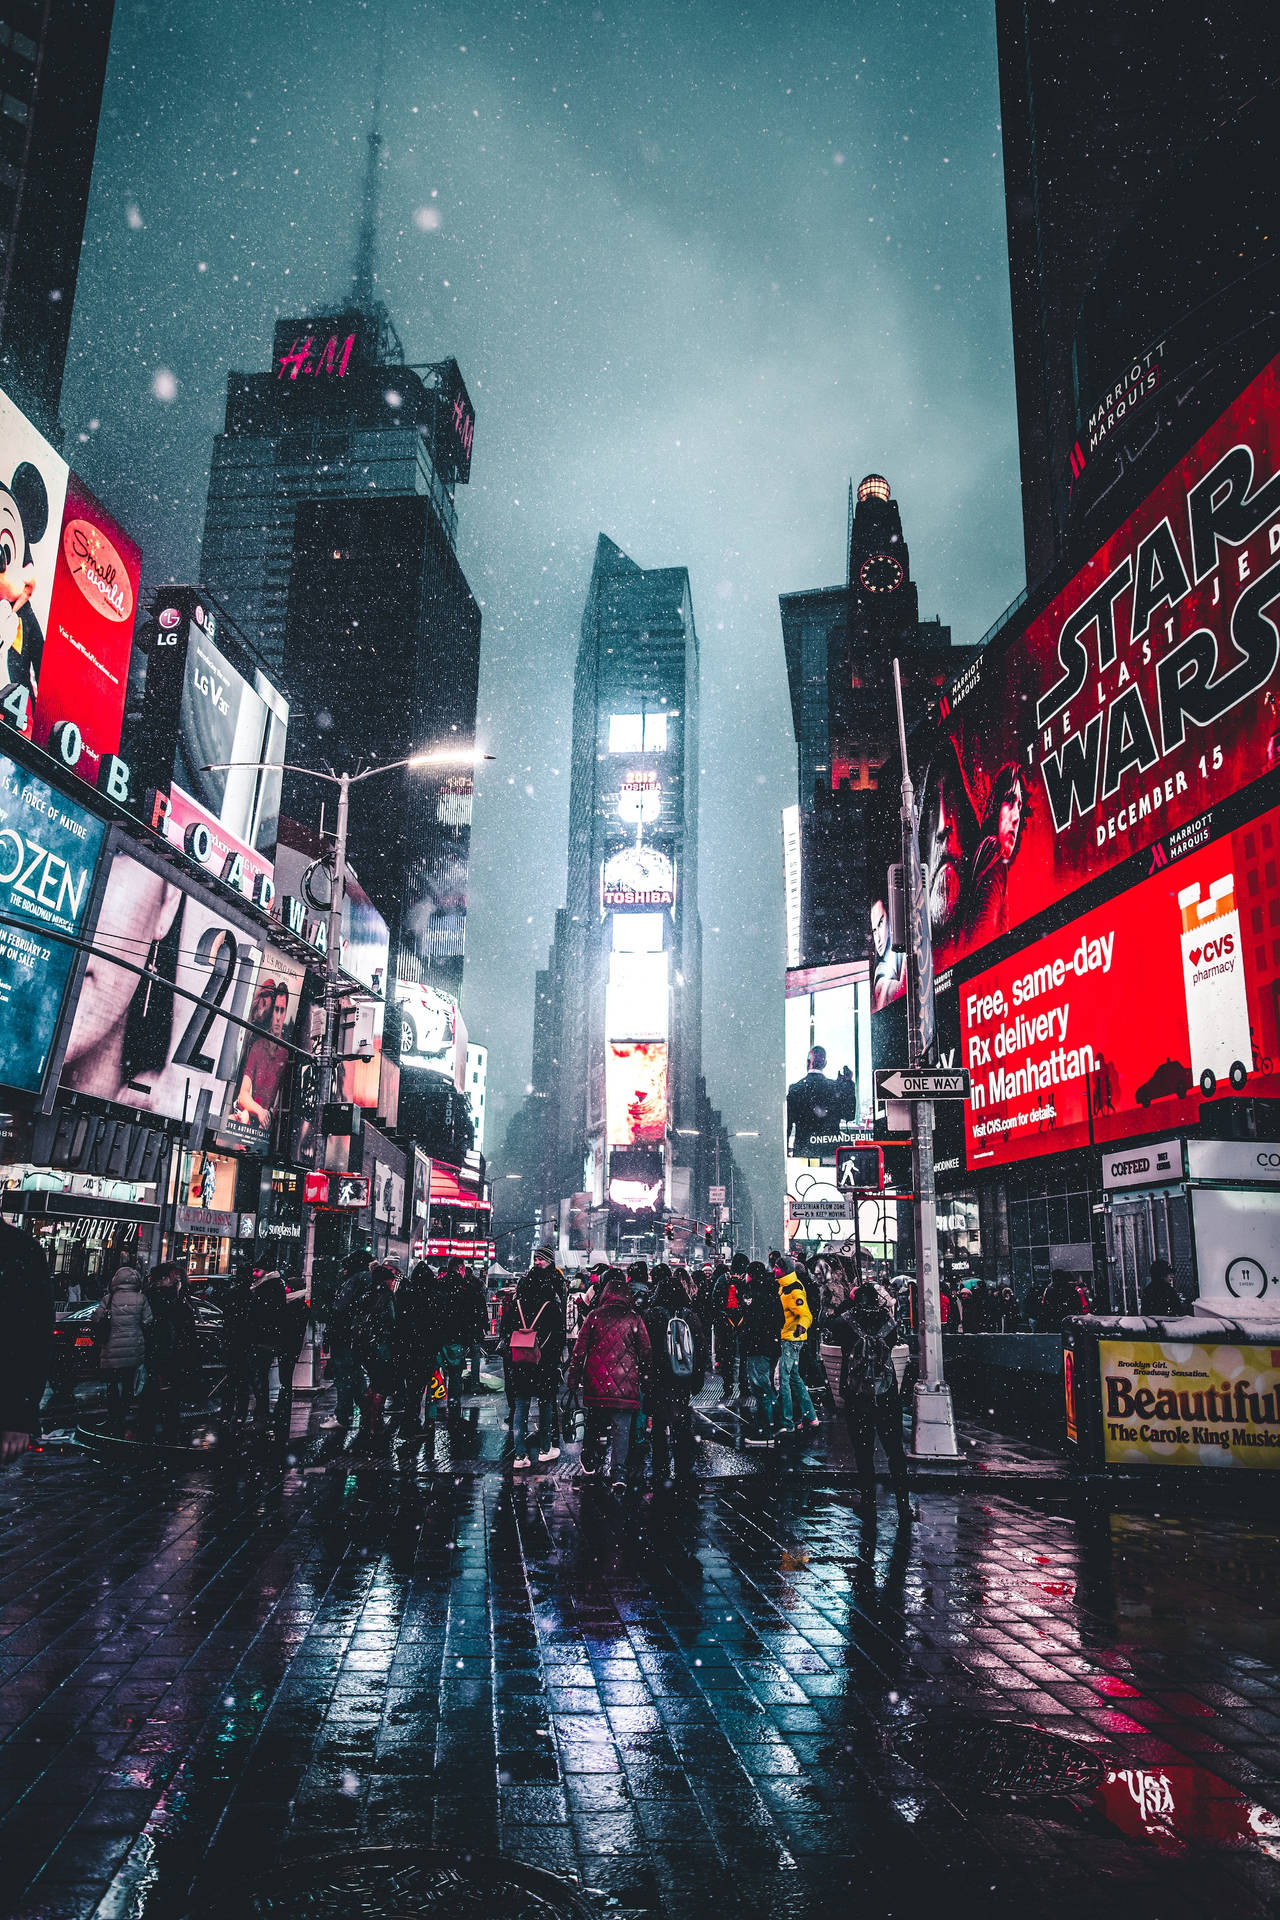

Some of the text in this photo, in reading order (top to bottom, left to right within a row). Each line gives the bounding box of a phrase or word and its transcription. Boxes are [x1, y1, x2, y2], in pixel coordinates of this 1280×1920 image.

[277, 333, 355, 380] H&M
[1089, 341, 1165, 433] MARRIOTT
[1090, 370, 1156, 452] MARQUIS
[72, 529, 117, 588] Small
[1036, 443, 1280, 730] STAR
[157, 633, 178, 646] LG
[203, 613, 215, 637] LG
[194, 667, 209, 696] LG
[952, 654, 984, 696] MARRIOTT
[952, 672, 981, 709] MARQUIS
[1028, 709, 1071, 765] THE
[1098, 616, 1174, 705] LAST
[1040, 558, 1280, 834] WARS
[620, 782, 661, 791] TOSHIBA
[1097, 744, 1224, 847] DECEMBER 15
[12, 787, 18, 796] A
[21, 789, 45, 814] FORCE
[48, 806, 59, 822] OF
[60, 813, 87, 841] NATURE
[1169, 812, 1213, 847] MARRIOTT
[1170, 829, 1210, 859] MARQUIS
[10, 892, 21, 908] THE
[21, 897, 52, 922] BROADWAY
[604, 891, 672, 903] TOSHIBA
[7, 932, 41, 957] FEBRUARY
[40, 948, 51, 961] 22
[7, 947, 18, 961] ON
[17, 952, 36, 968] SALE
[1203, 933, 1235, 962] CVS
[966, 931, 1115, 1029] Free, same-day
[1193, 956, 1235, 985] pharmacy
[968, 1003, 1069, 1069] Rx delivery
[904, 1078, 960, 1090] ONE WAY
[971, 1078, 986, 1111] in
[988, 1044, 1101, 1105] Manhattan.
[972, 1103, 1057, 1138] Visit CVS.com for details.
[1111, 1157, 1150, 1177] COFFEED
[123, 1222, 138, 1242] 21
[268, 1221, 291, 1239] sunglass
[1117, 1360, 1168, 1379] Brooklyn Girl.
[1133, 1369, 1210, 1378] Broadway Sensation.
[1107, 1423, 1138, 1441] The
[1139, 1424, 1190, 1444] Carole
[1191, 1426, 1230, 1449] King
